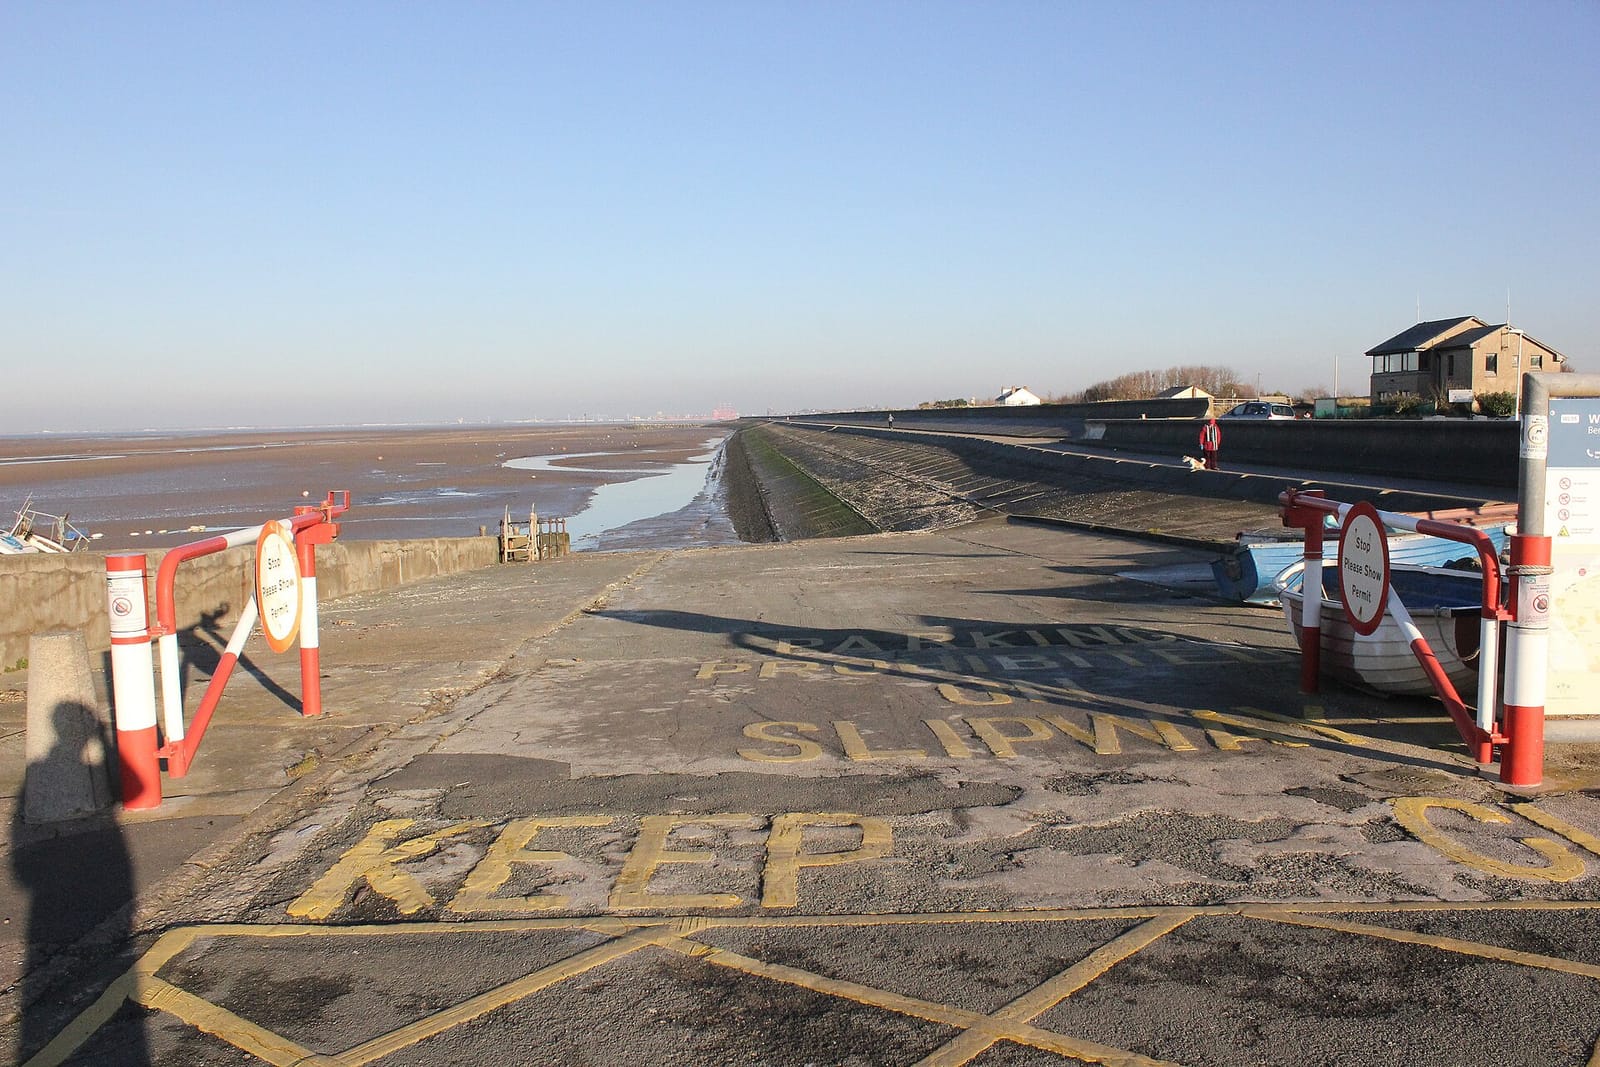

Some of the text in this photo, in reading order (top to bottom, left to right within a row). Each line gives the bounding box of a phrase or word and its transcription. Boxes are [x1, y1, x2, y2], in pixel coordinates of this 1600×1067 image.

[1355, 536, 1371, 554] Stop
[1344, 557, 1382, 581] Please Show
[1351, 584, 1372, 603] Permit
[775, 626, 1180, 654] PARKING
[736, 704, 1368, 764] SLIPWAY
[286, 812, 894, 920] KEEP
